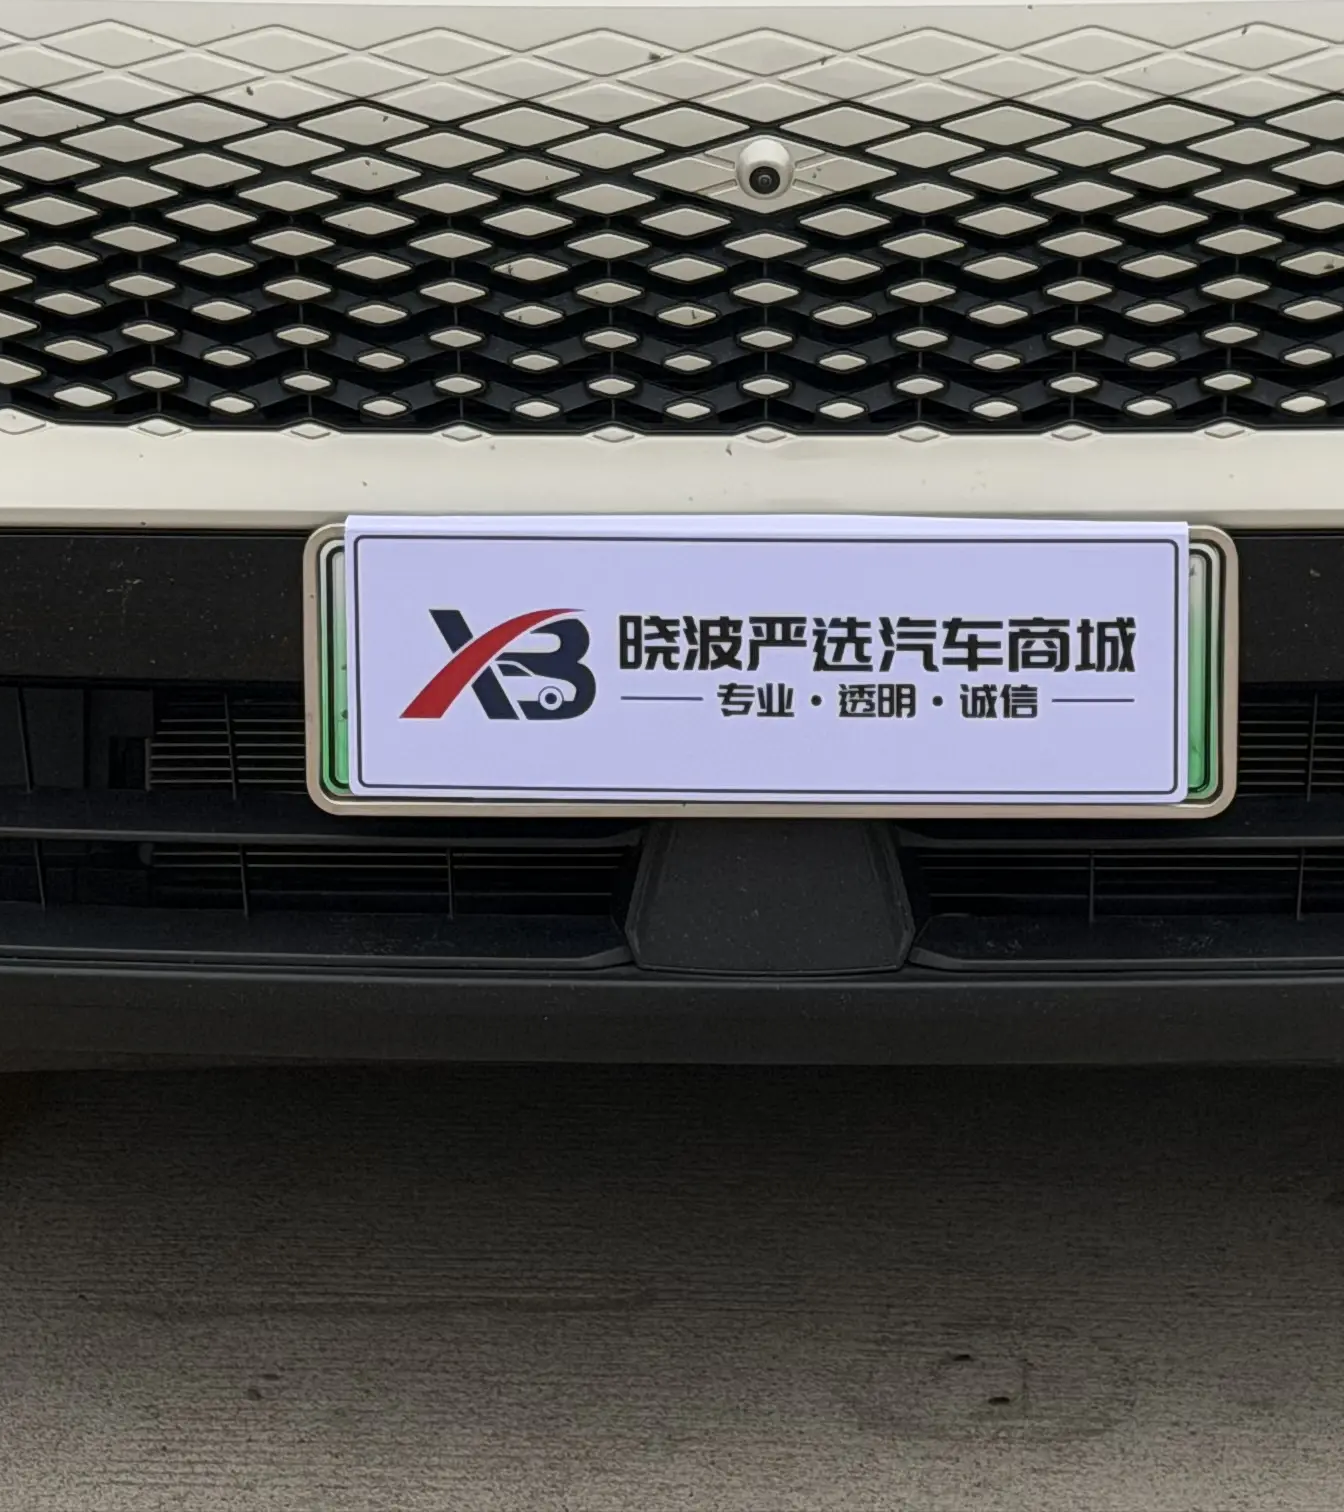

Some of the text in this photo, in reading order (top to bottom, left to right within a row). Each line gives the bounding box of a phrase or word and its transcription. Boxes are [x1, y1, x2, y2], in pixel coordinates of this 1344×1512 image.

[399, 608, 597, 721] XB
[618, 614, 1137, 674] 晓波严选汽车商城
